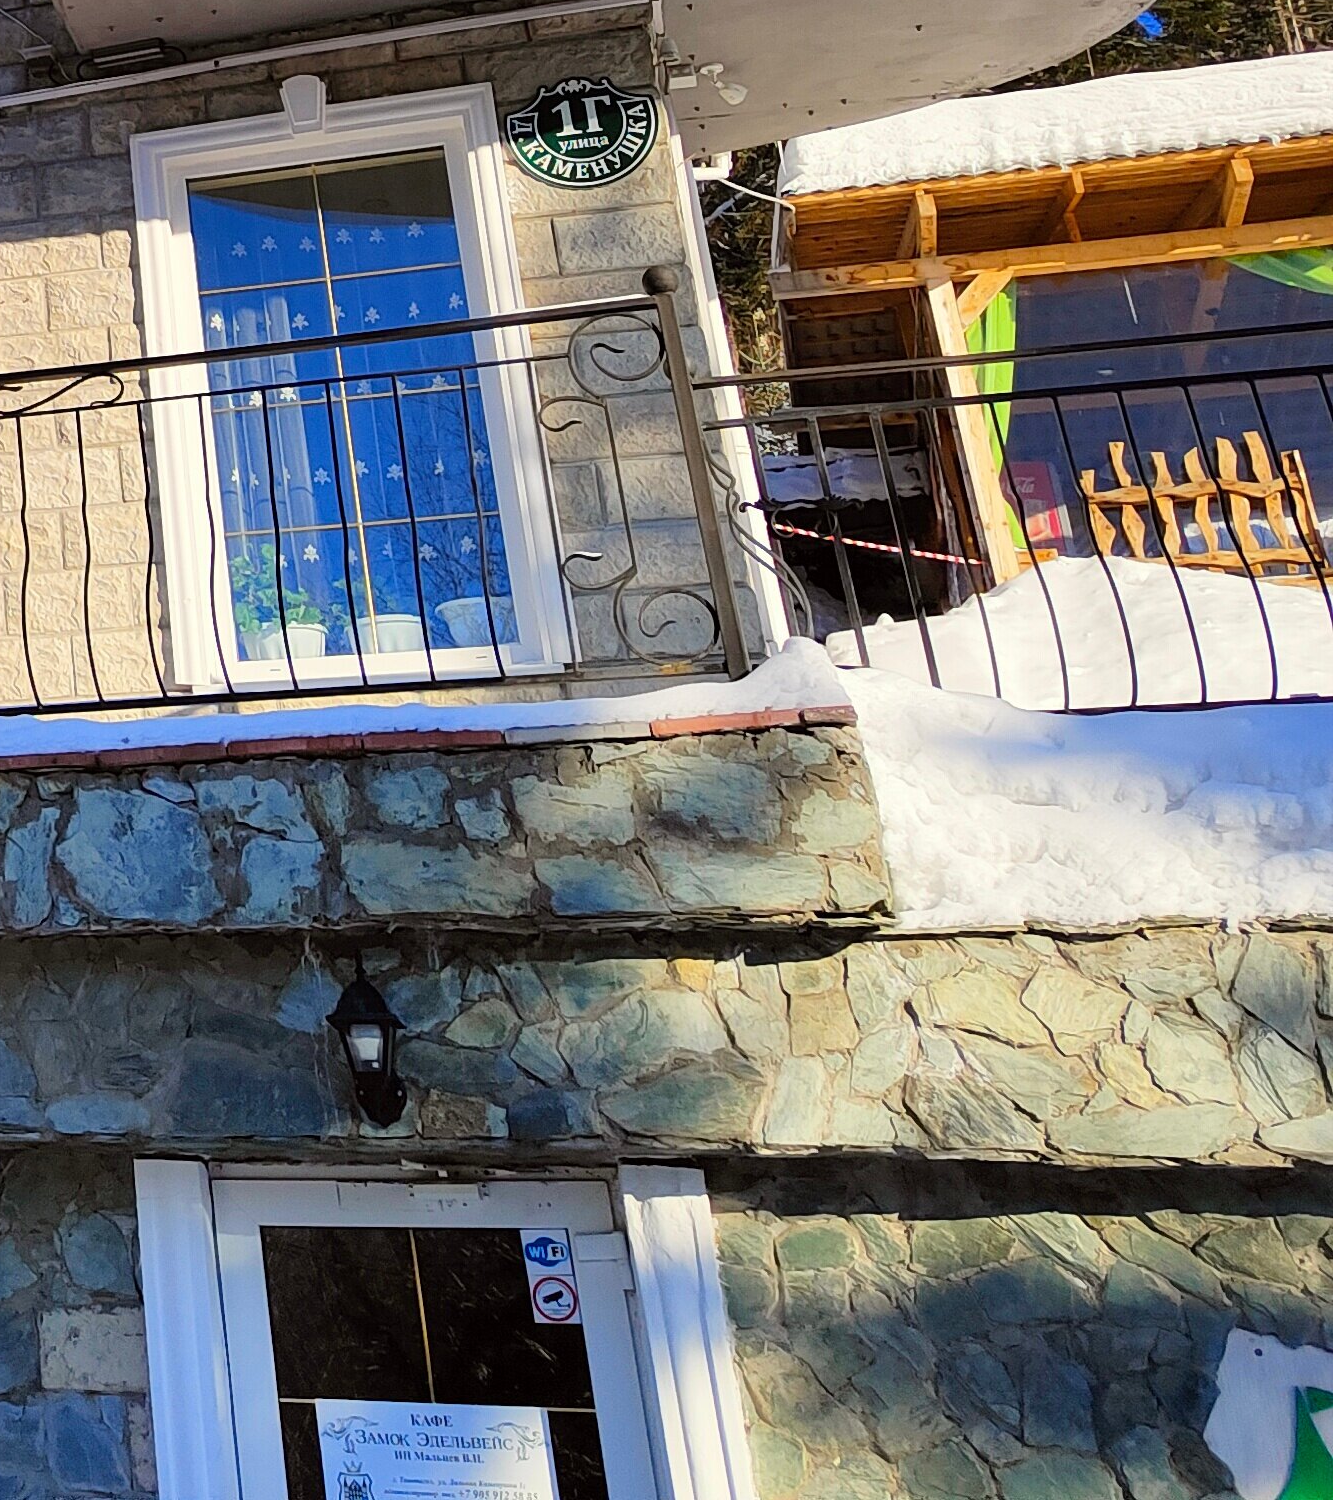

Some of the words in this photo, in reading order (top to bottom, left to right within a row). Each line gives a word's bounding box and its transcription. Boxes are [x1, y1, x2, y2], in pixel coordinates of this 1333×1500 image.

[551, 94, 611, 137] 1Г
[521, 103, 649, 179] КАМЕНУШКА
[558, 134, 610, 154] улица
[410, 1413, 454, 1428] КАФЕ
[354, 1429, 411, 1448] ЗАМОК
